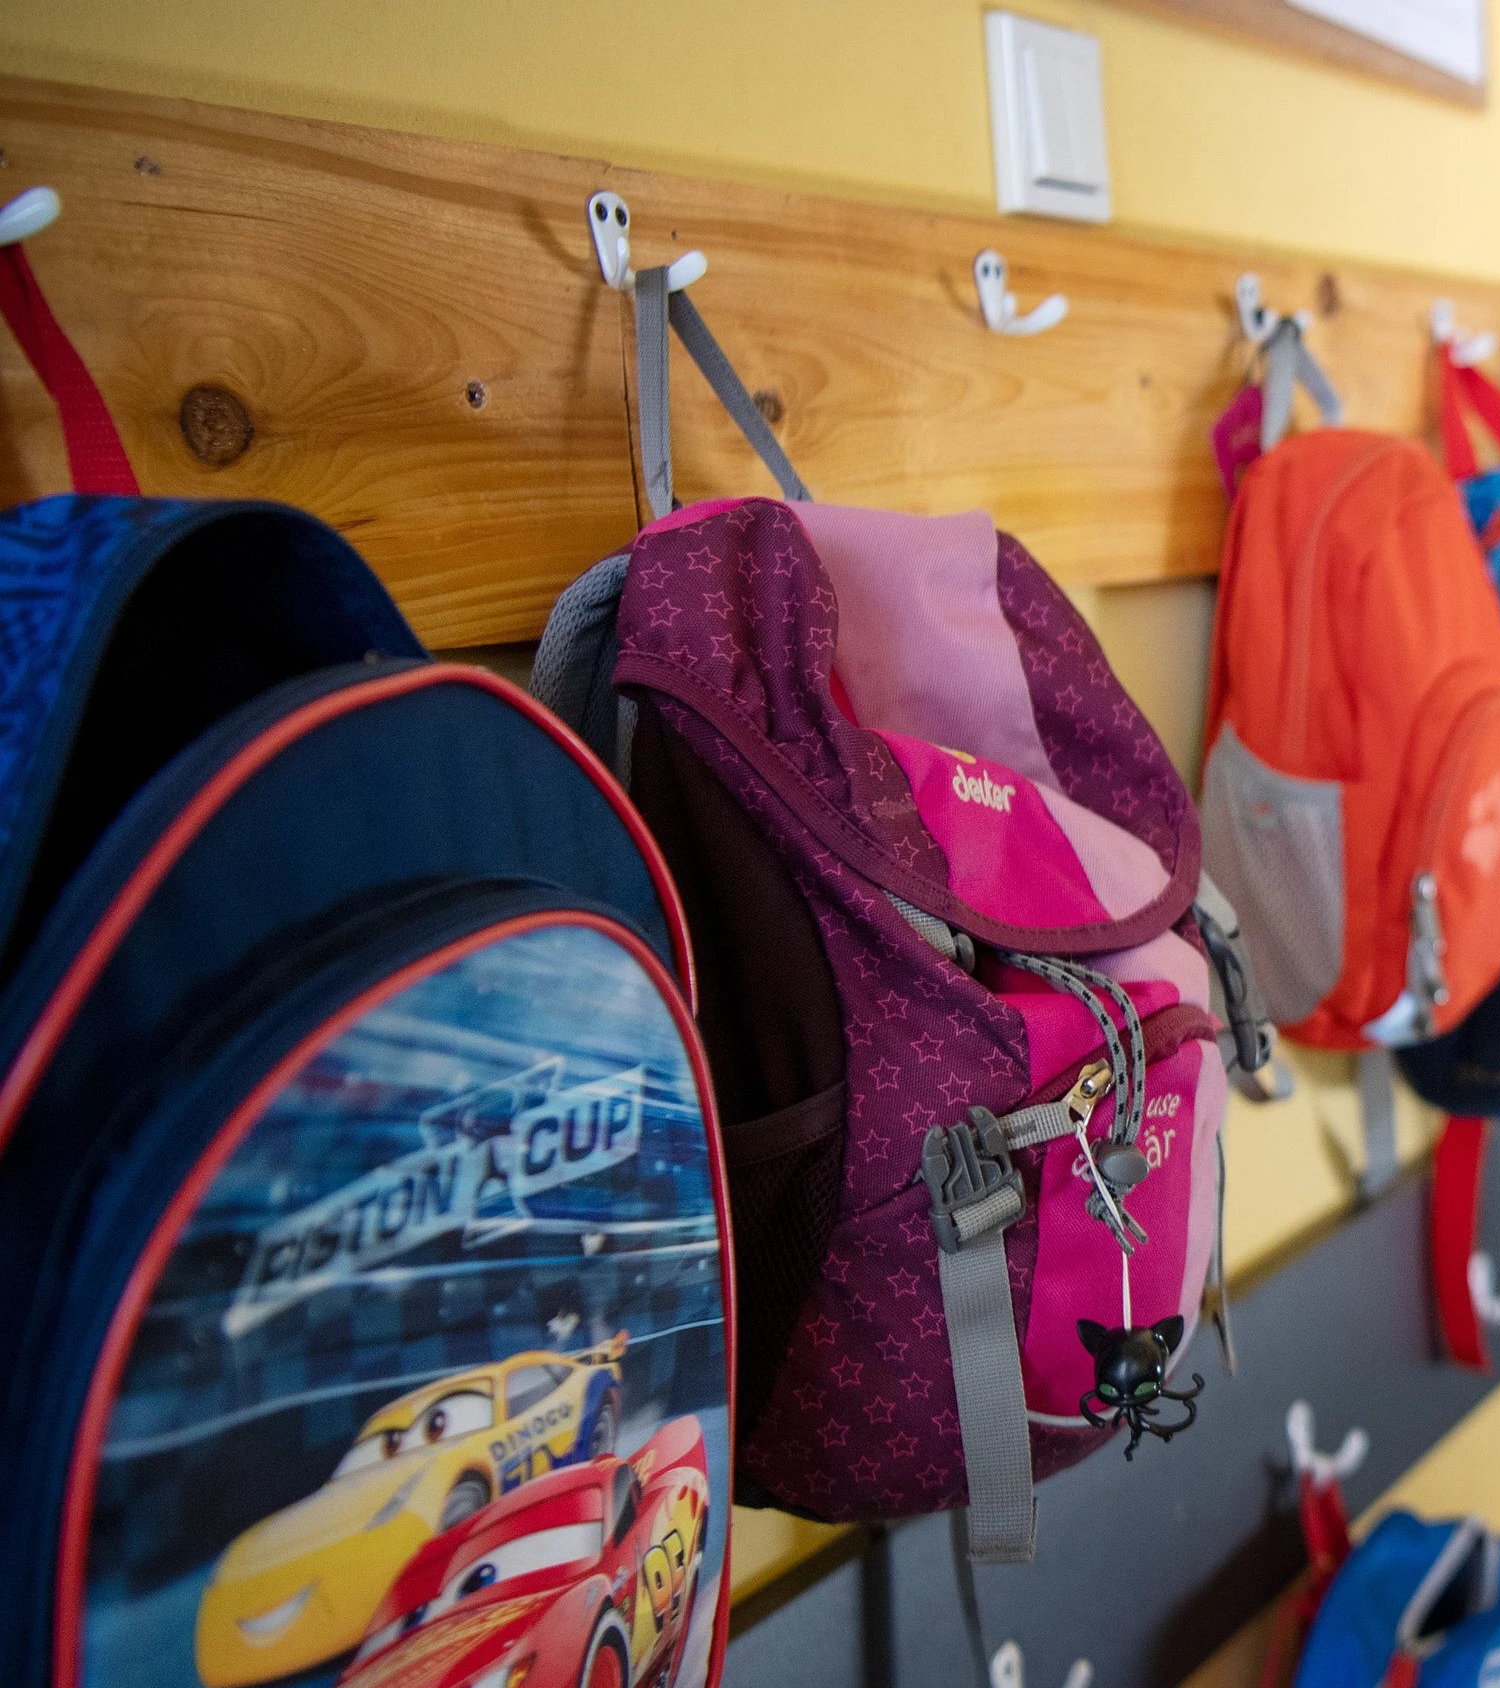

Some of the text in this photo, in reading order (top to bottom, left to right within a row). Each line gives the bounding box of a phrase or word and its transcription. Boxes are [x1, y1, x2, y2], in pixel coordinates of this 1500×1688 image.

[953, 763, 1016, 813] deuter
[1146, 1093, 1180, 1118] use
[521, 1097, 633, 1176] CUP
